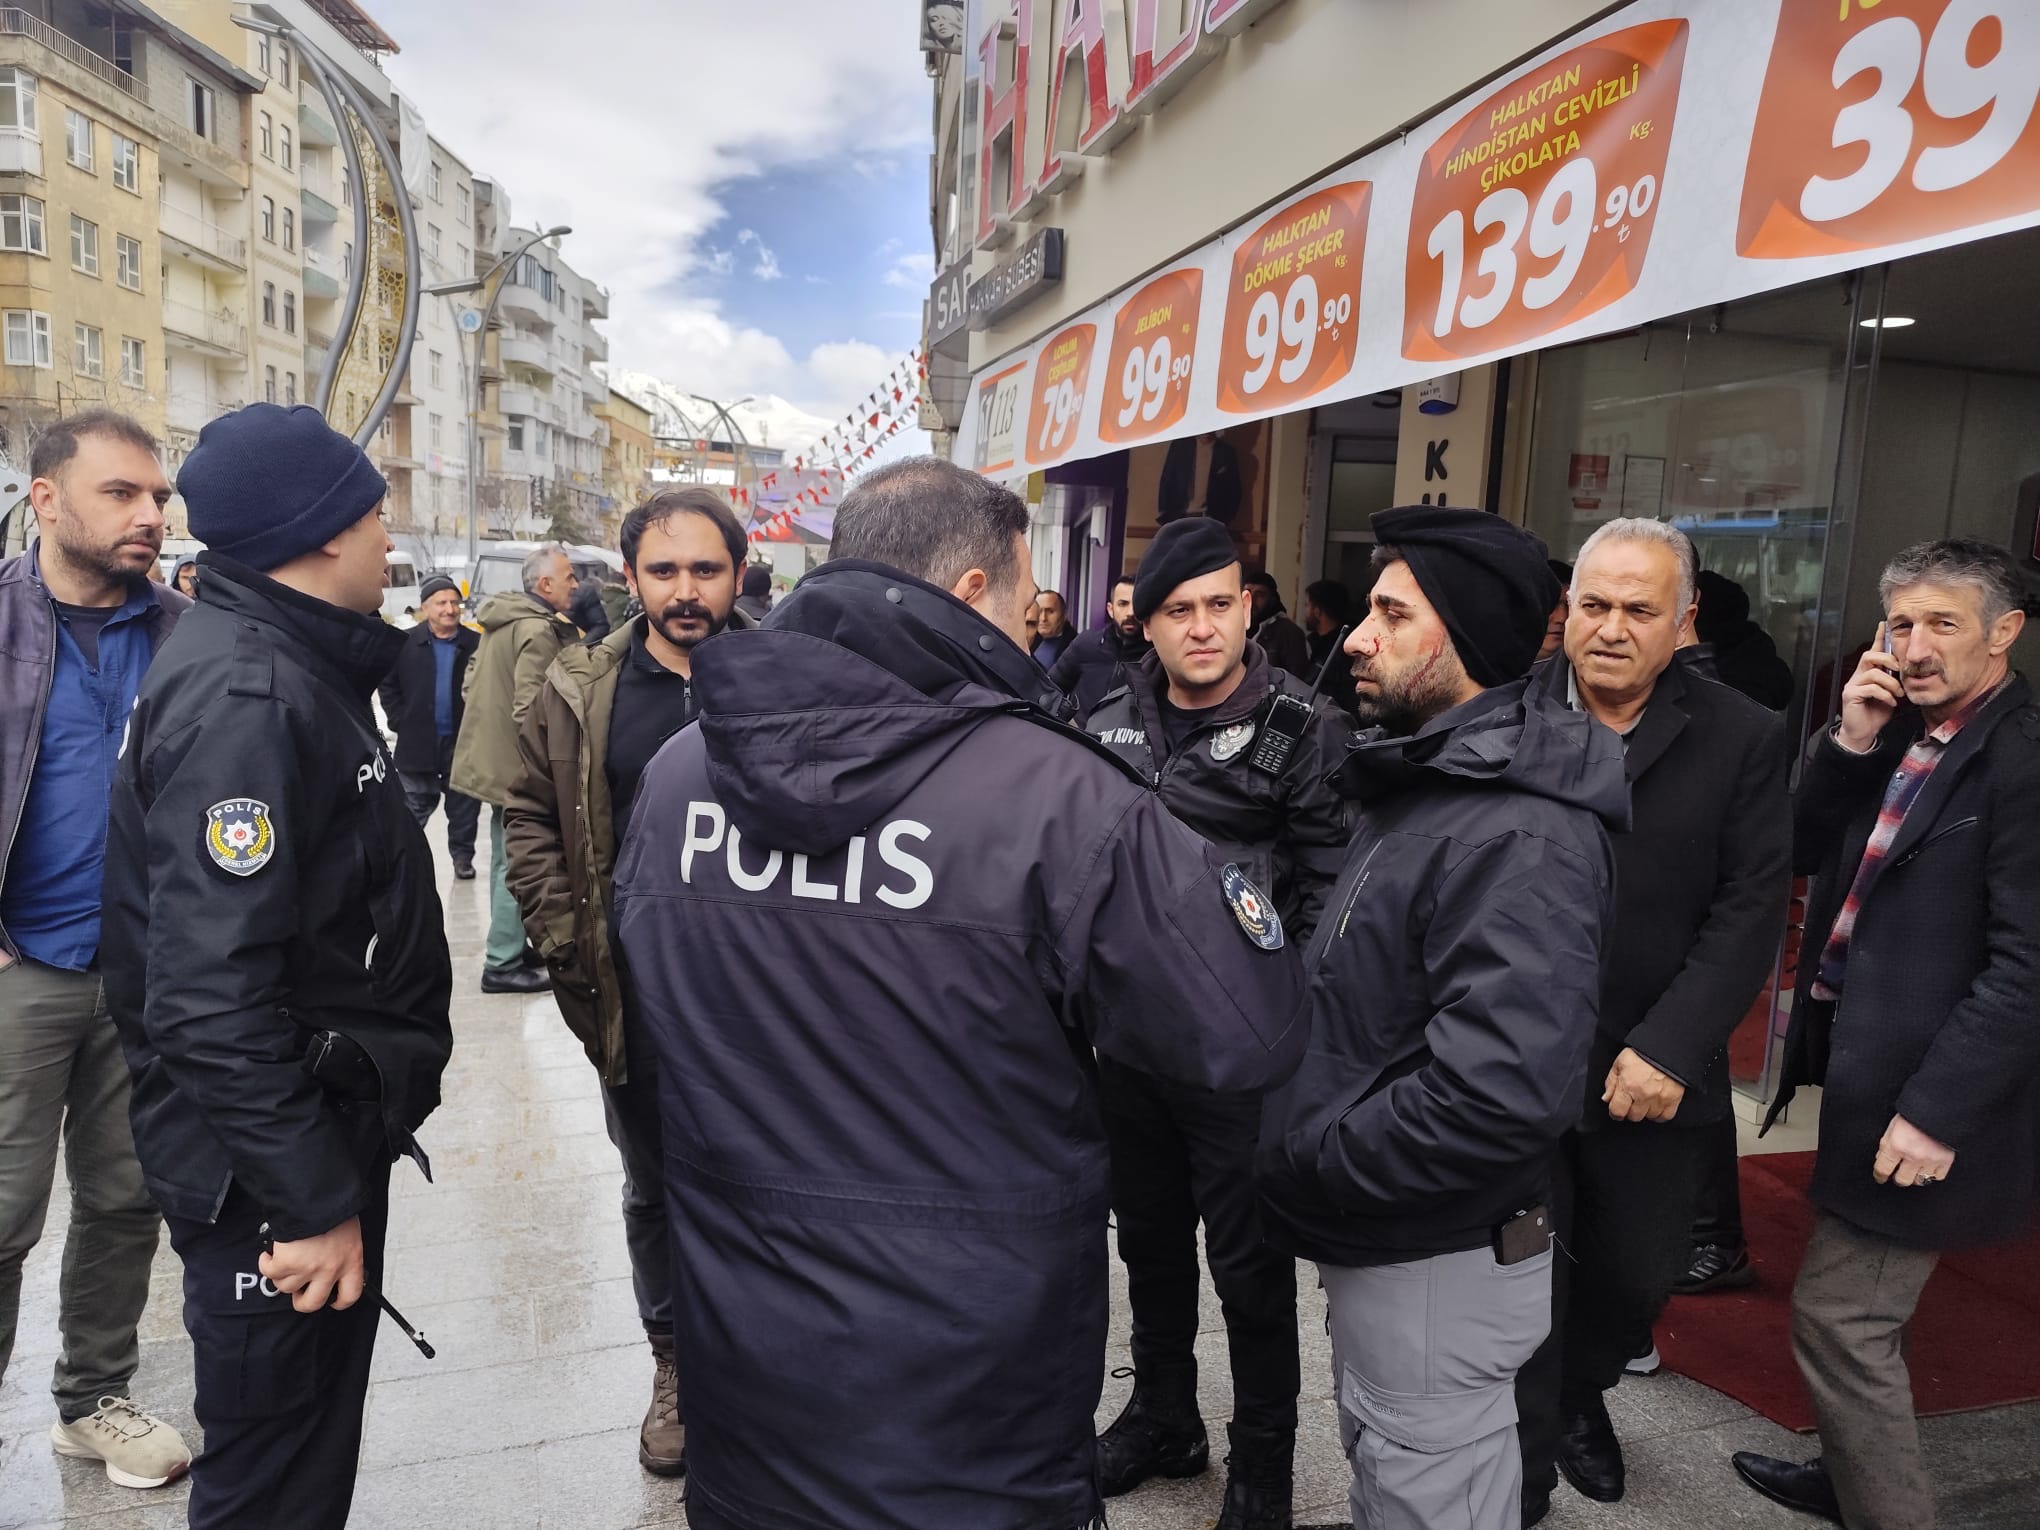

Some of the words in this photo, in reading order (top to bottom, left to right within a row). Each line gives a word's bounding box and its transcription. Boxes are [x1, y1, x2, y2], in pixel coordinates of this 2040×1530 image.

[1445, 113, 1546, 179] HİNDİSTAN
[1553, 63, 1640, 127] CEVİZLİ
[1490, 64, 1581, 129] HALKTAN
[1480, 130, 1581, 193] ÇİKOLATA
[1244, 252, 1293, 293] DÖKME
[1296, 228, 1345, 273] ŞEKER
[1262, 205, 1332, 257] HALKTAN
